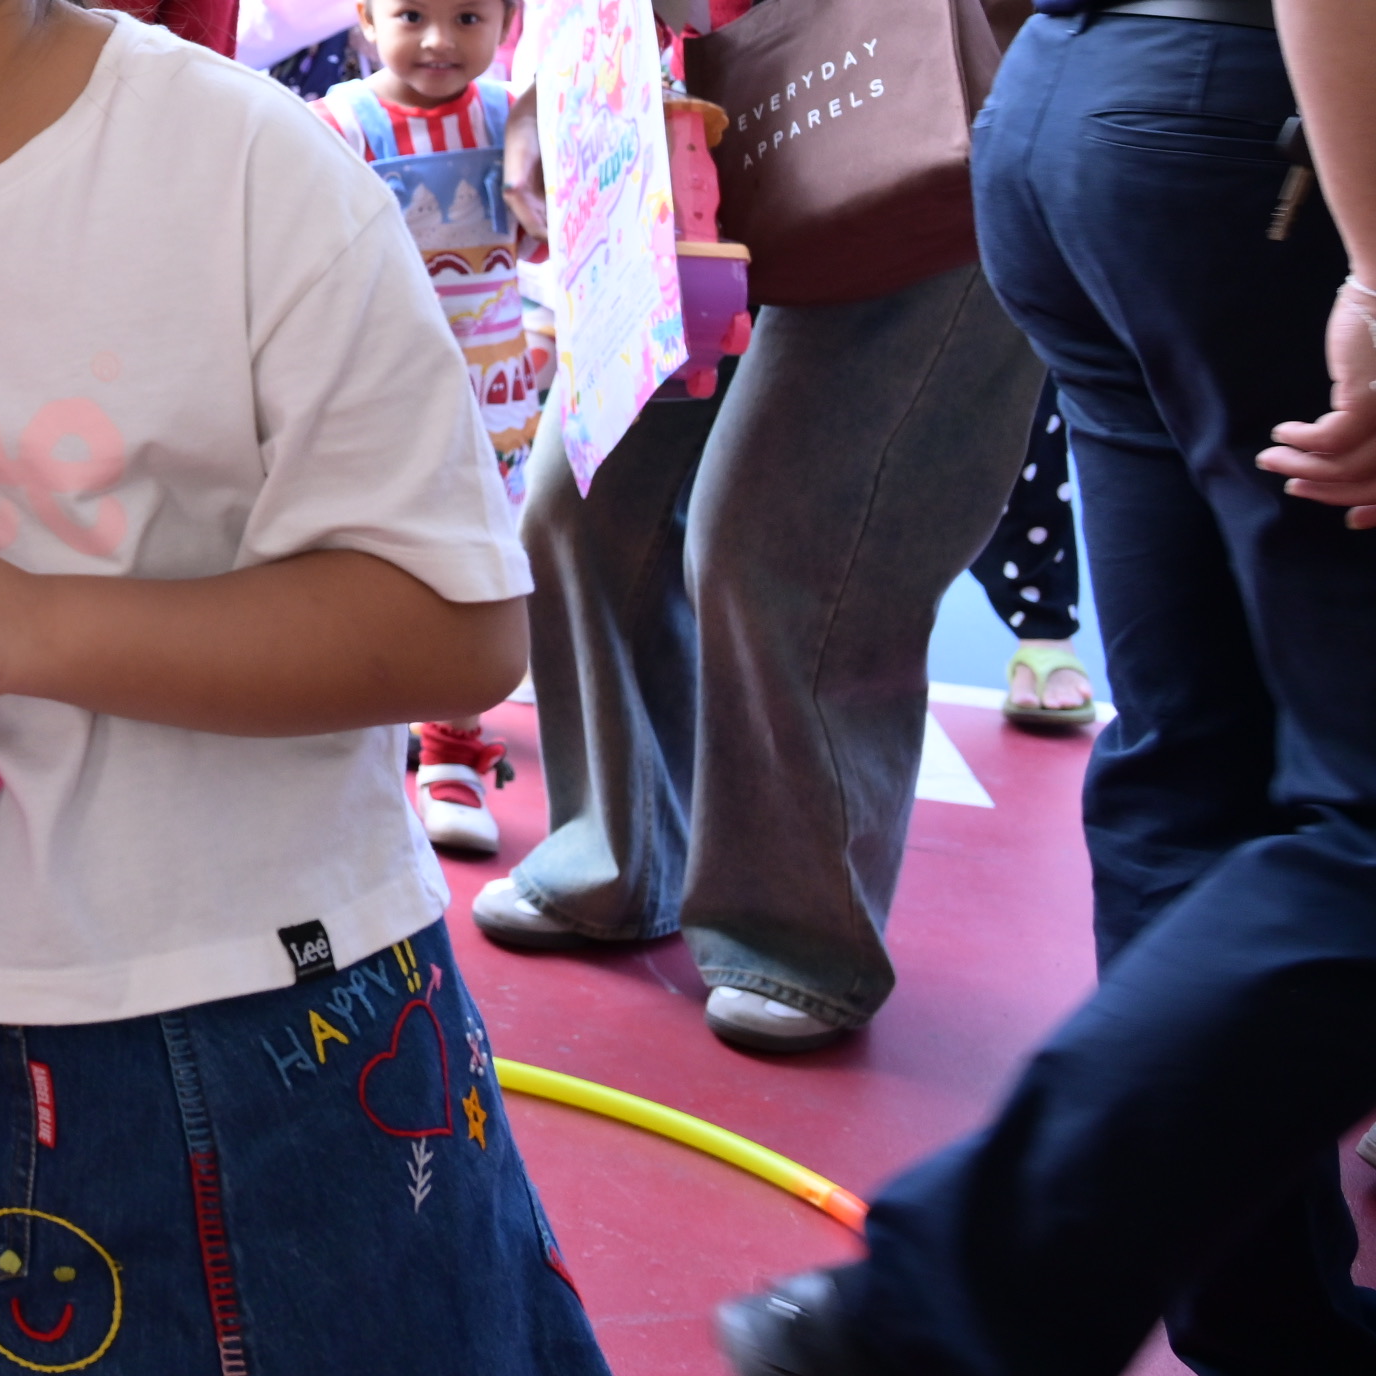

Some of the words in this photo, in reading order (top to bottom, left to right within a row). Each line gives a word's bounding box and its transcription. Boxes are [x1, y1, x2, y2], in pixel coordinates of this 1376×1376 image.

[737, 37, 878, 132] EVERYDAY
[743, 78, 885, 171] APPARELS
[290, 937, 330, 967] Lee
